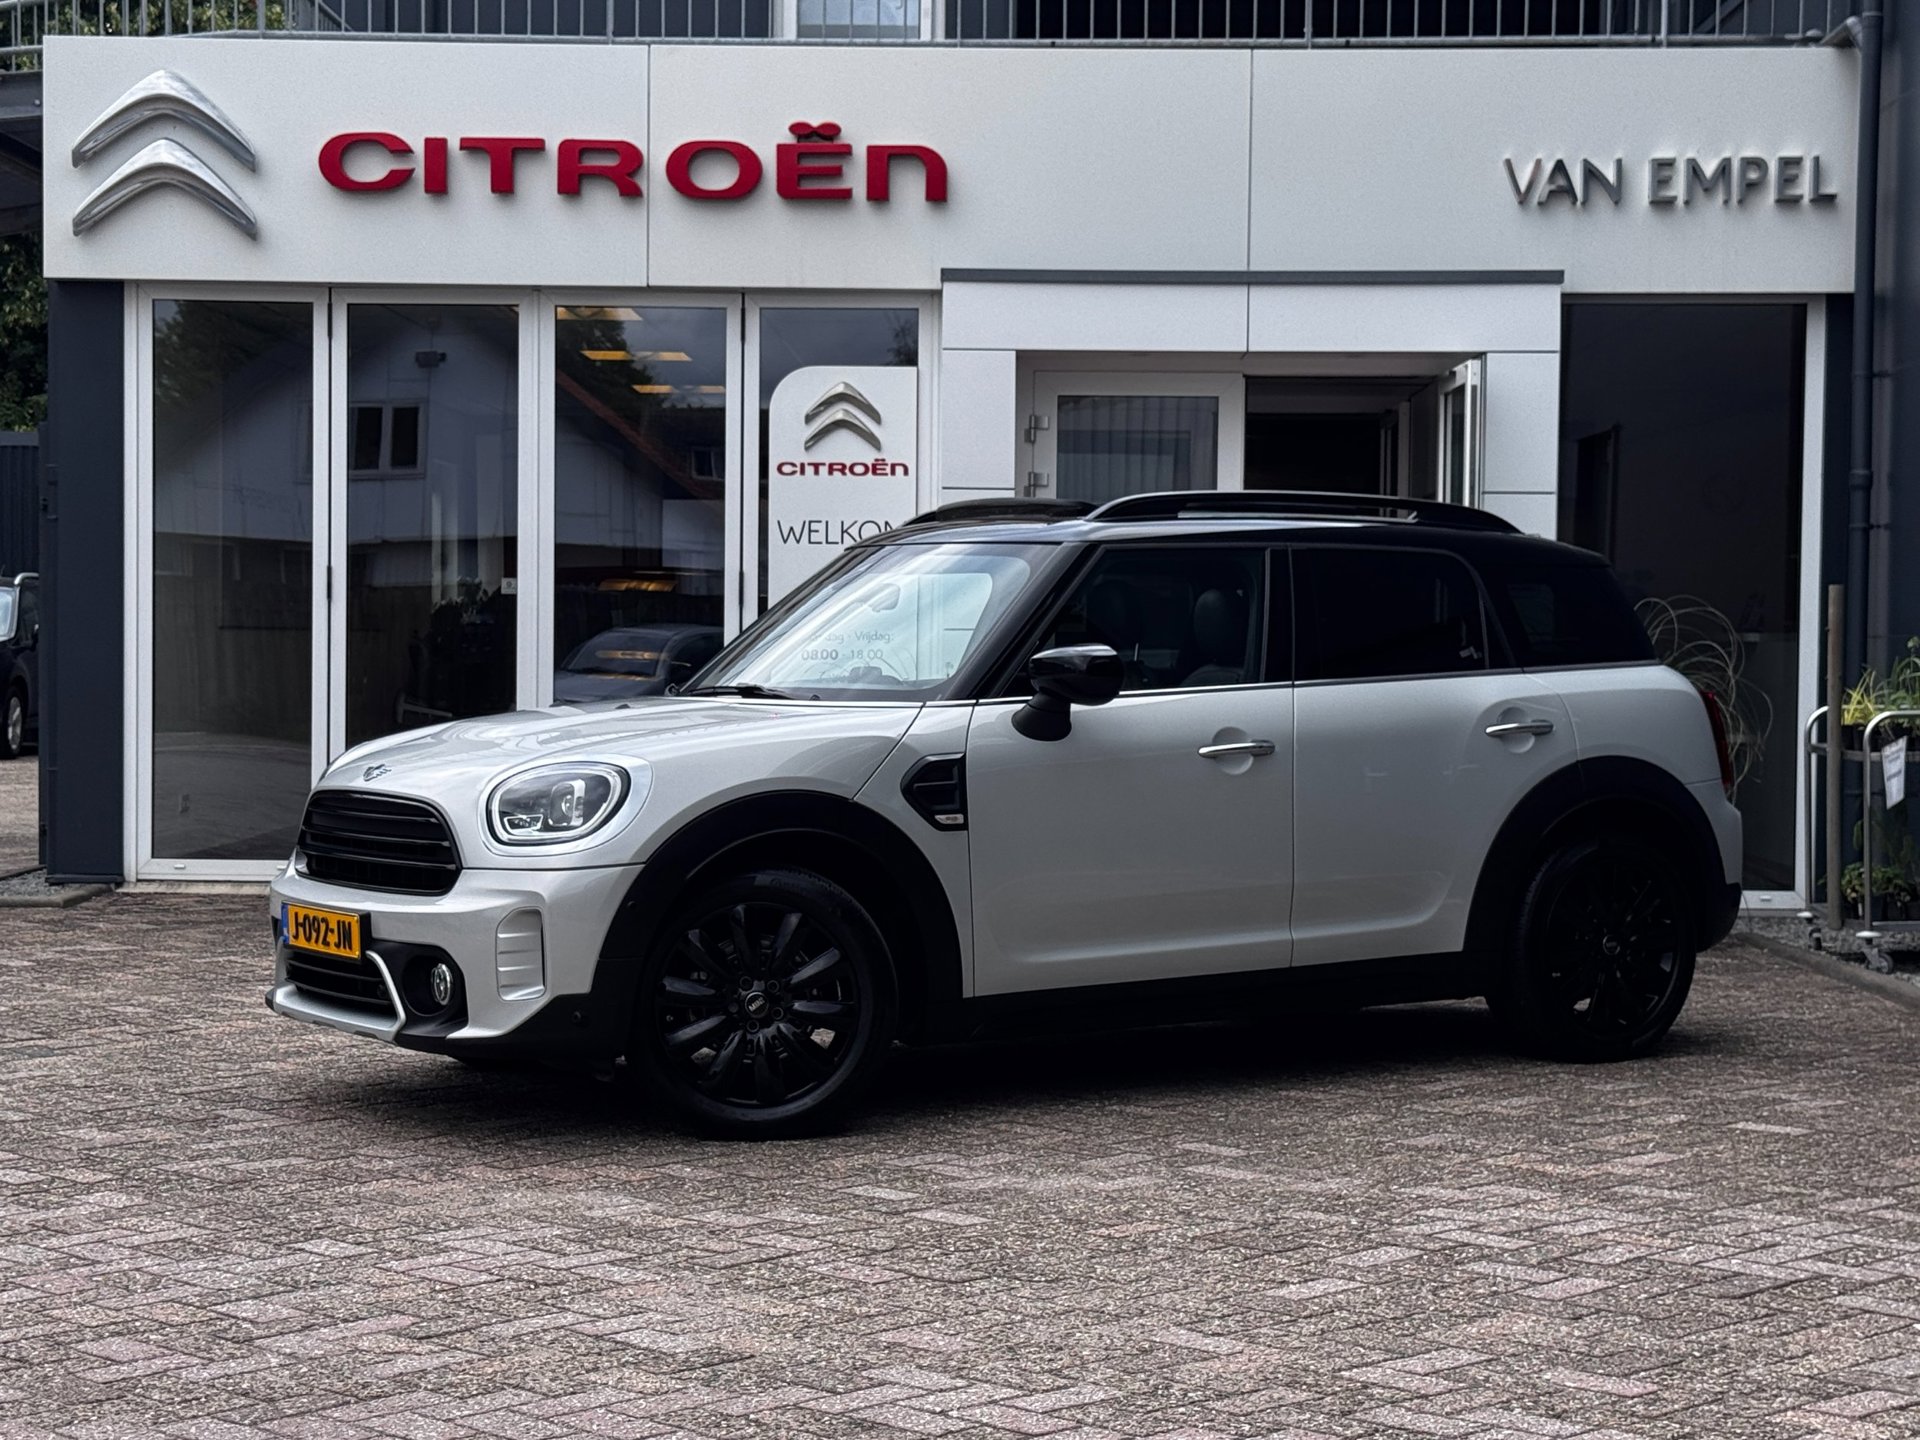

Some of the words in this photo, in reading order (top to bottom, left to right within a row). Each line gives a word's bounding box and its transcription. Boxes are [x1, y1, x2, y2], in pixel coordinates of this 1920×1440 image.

[1503, 157, 1623, 206] VAN
[1648, 155, 1838, 206] EMPEL
[292, 911, 353, 952] J-092-JN
